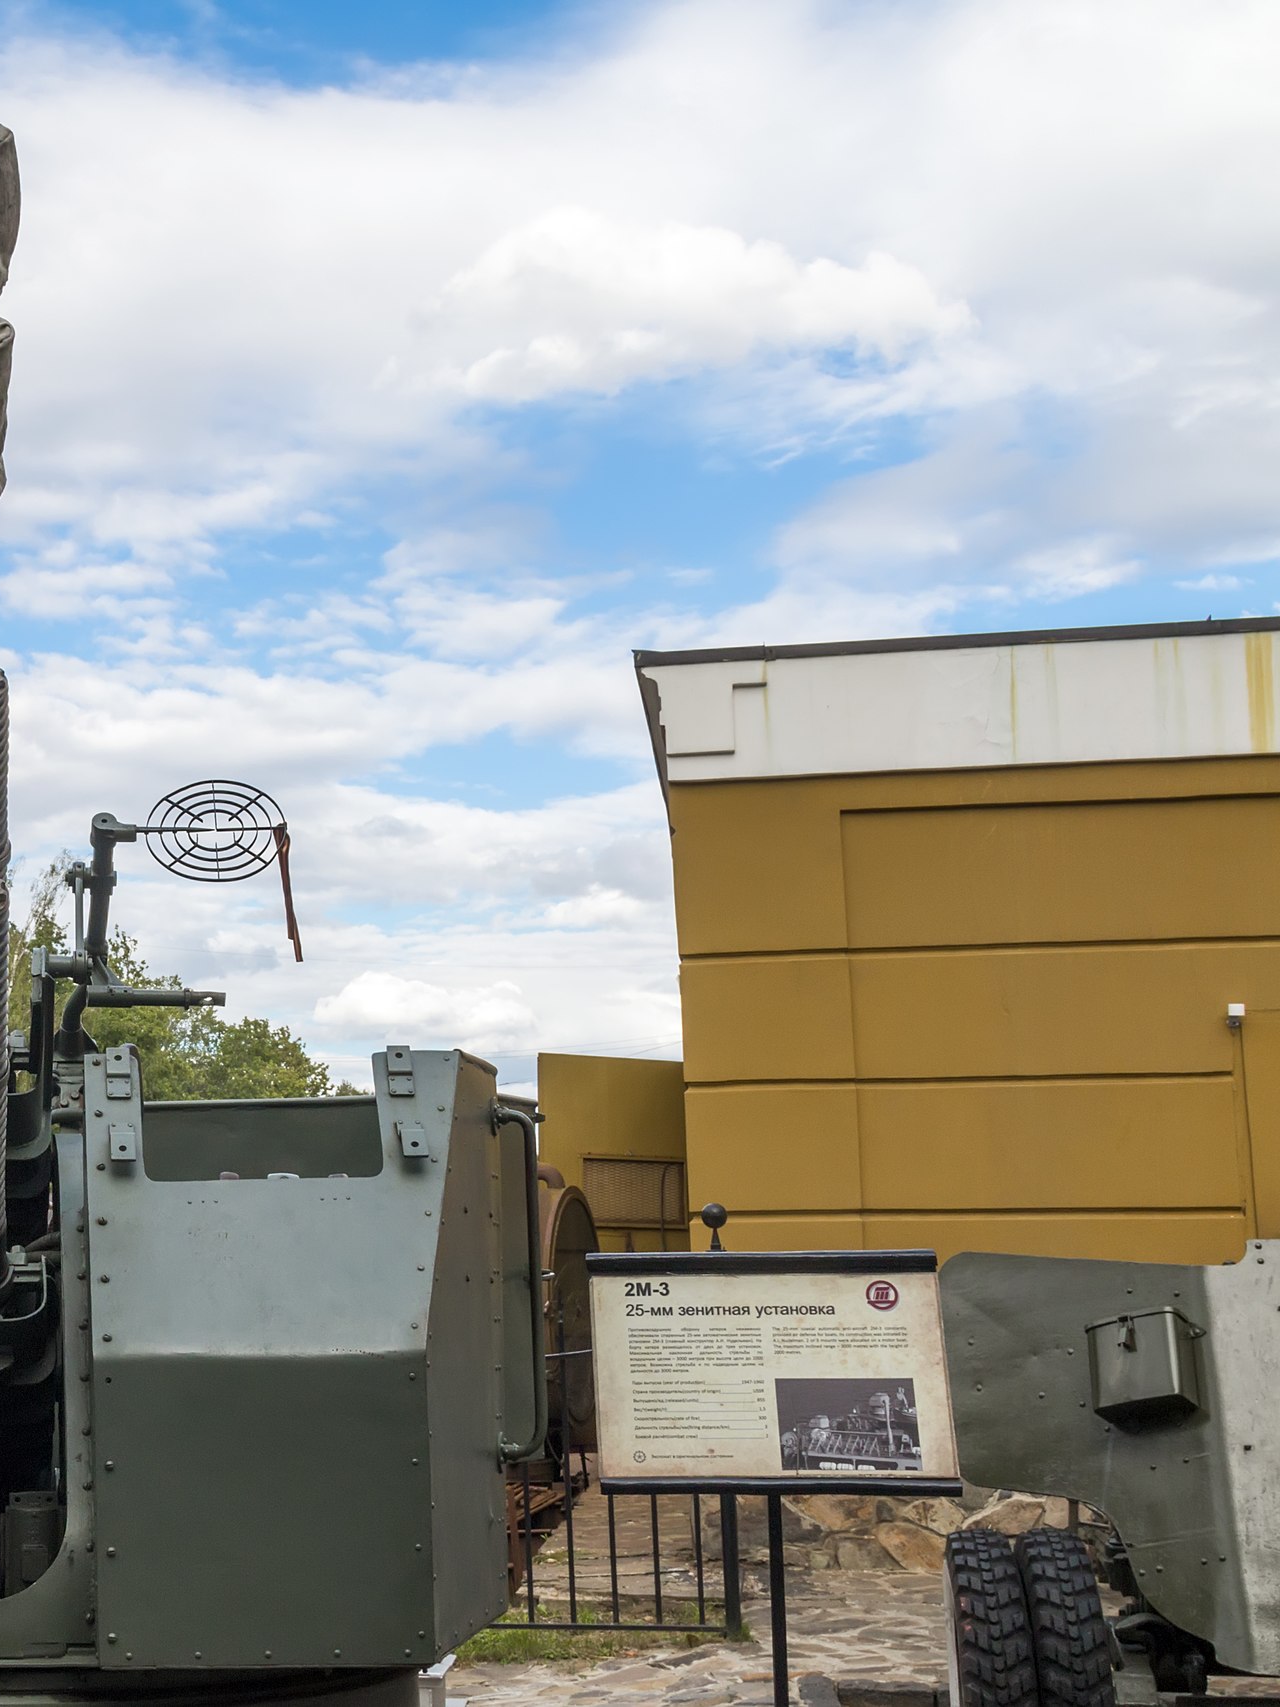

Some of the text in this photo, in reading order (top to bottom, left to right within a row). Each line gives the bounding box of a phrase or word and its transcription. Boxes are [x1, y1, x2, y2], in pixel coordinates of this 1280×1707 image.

[624, 1282, 670, 1297] 2М-3
[625, 1304, 836, 1319] 25-мм зенитная установка
